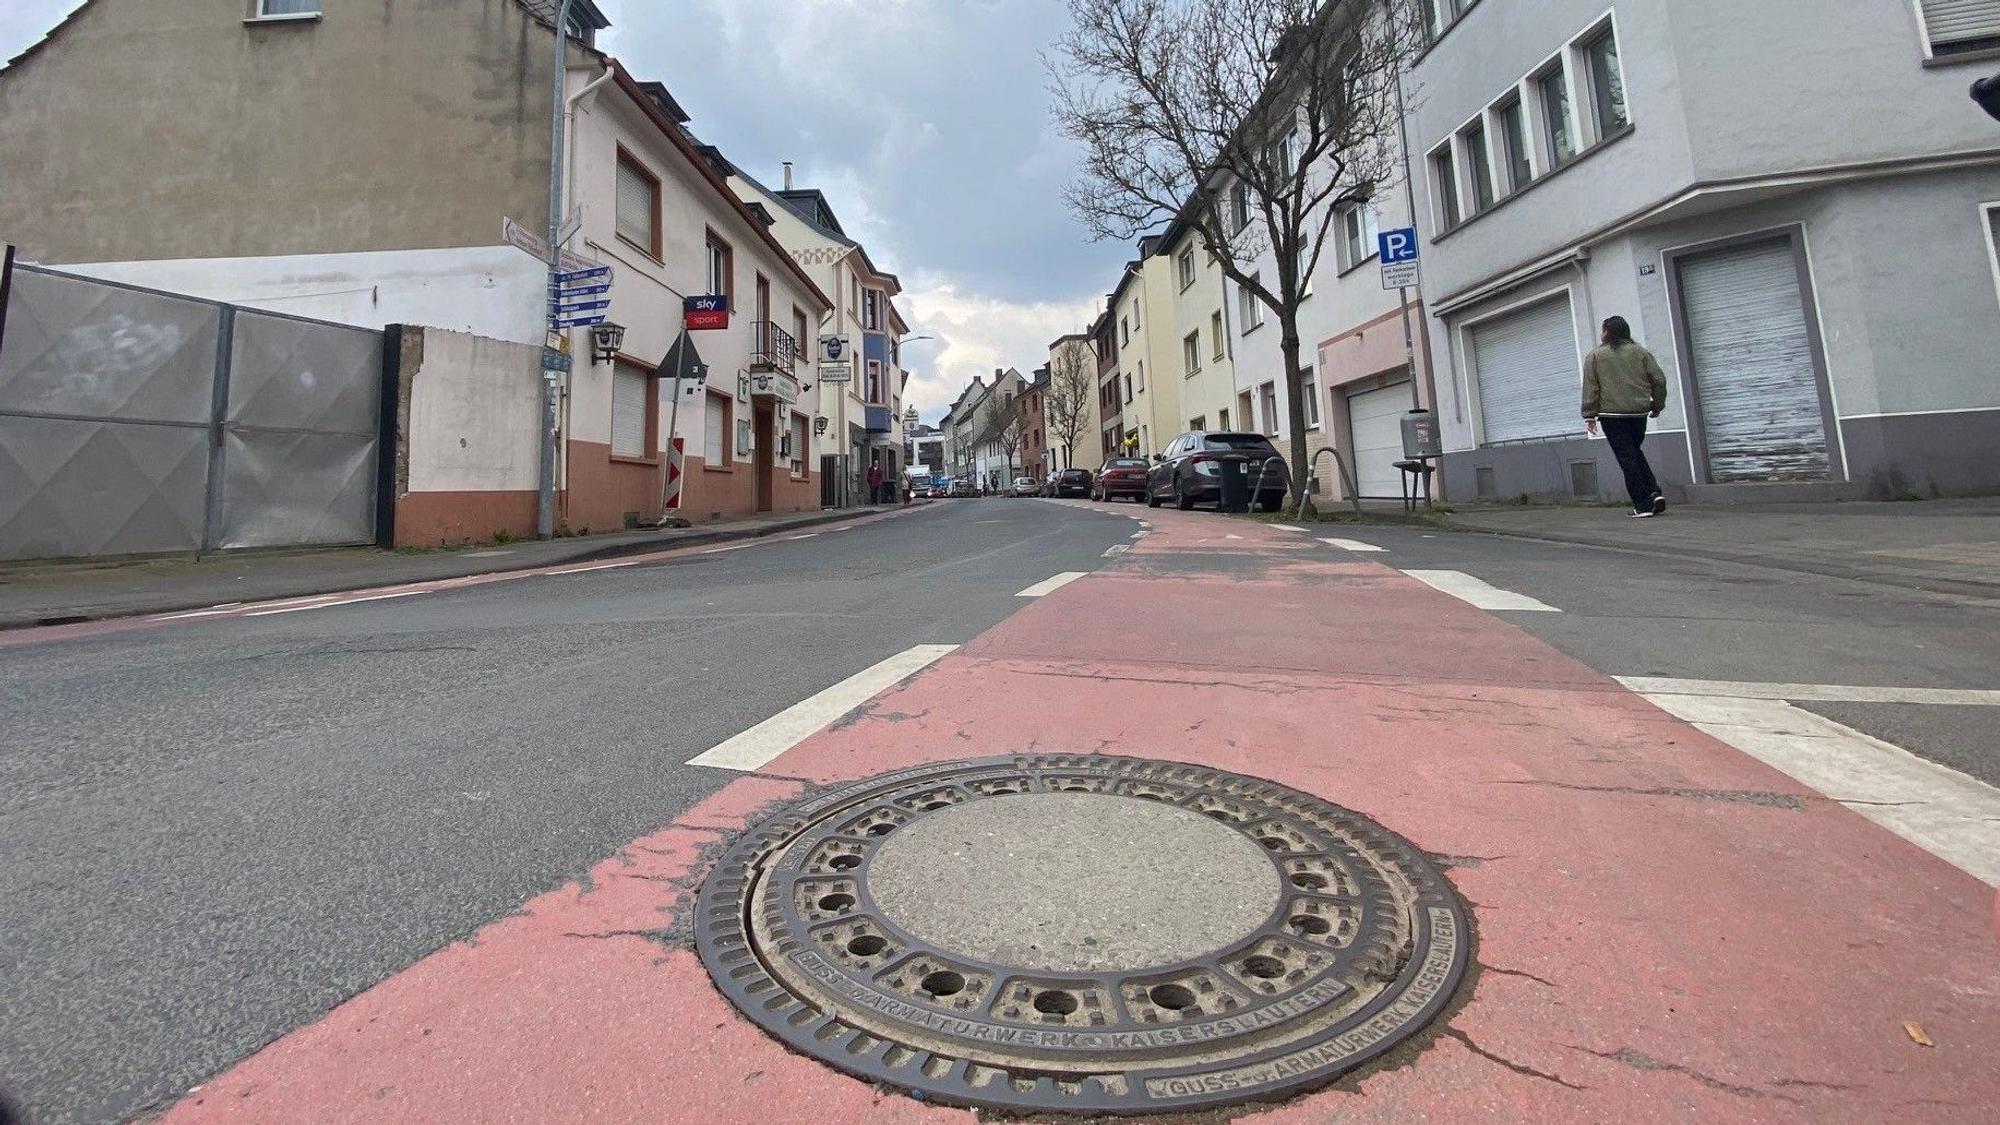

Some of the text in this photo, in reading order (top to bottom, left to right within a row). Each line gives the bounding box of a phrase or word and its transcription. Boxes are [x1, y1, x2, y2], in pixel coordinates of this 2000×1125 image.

[1387, 233, 1407, 259] P
[696, 298, 717, 311] sky
[693, 315, 719, 326] sport
[1405, 908, 1455, 1012] KAISERSLAUTERN
[1111, 978, 1341, 1048] KAISERSLAUTERN
